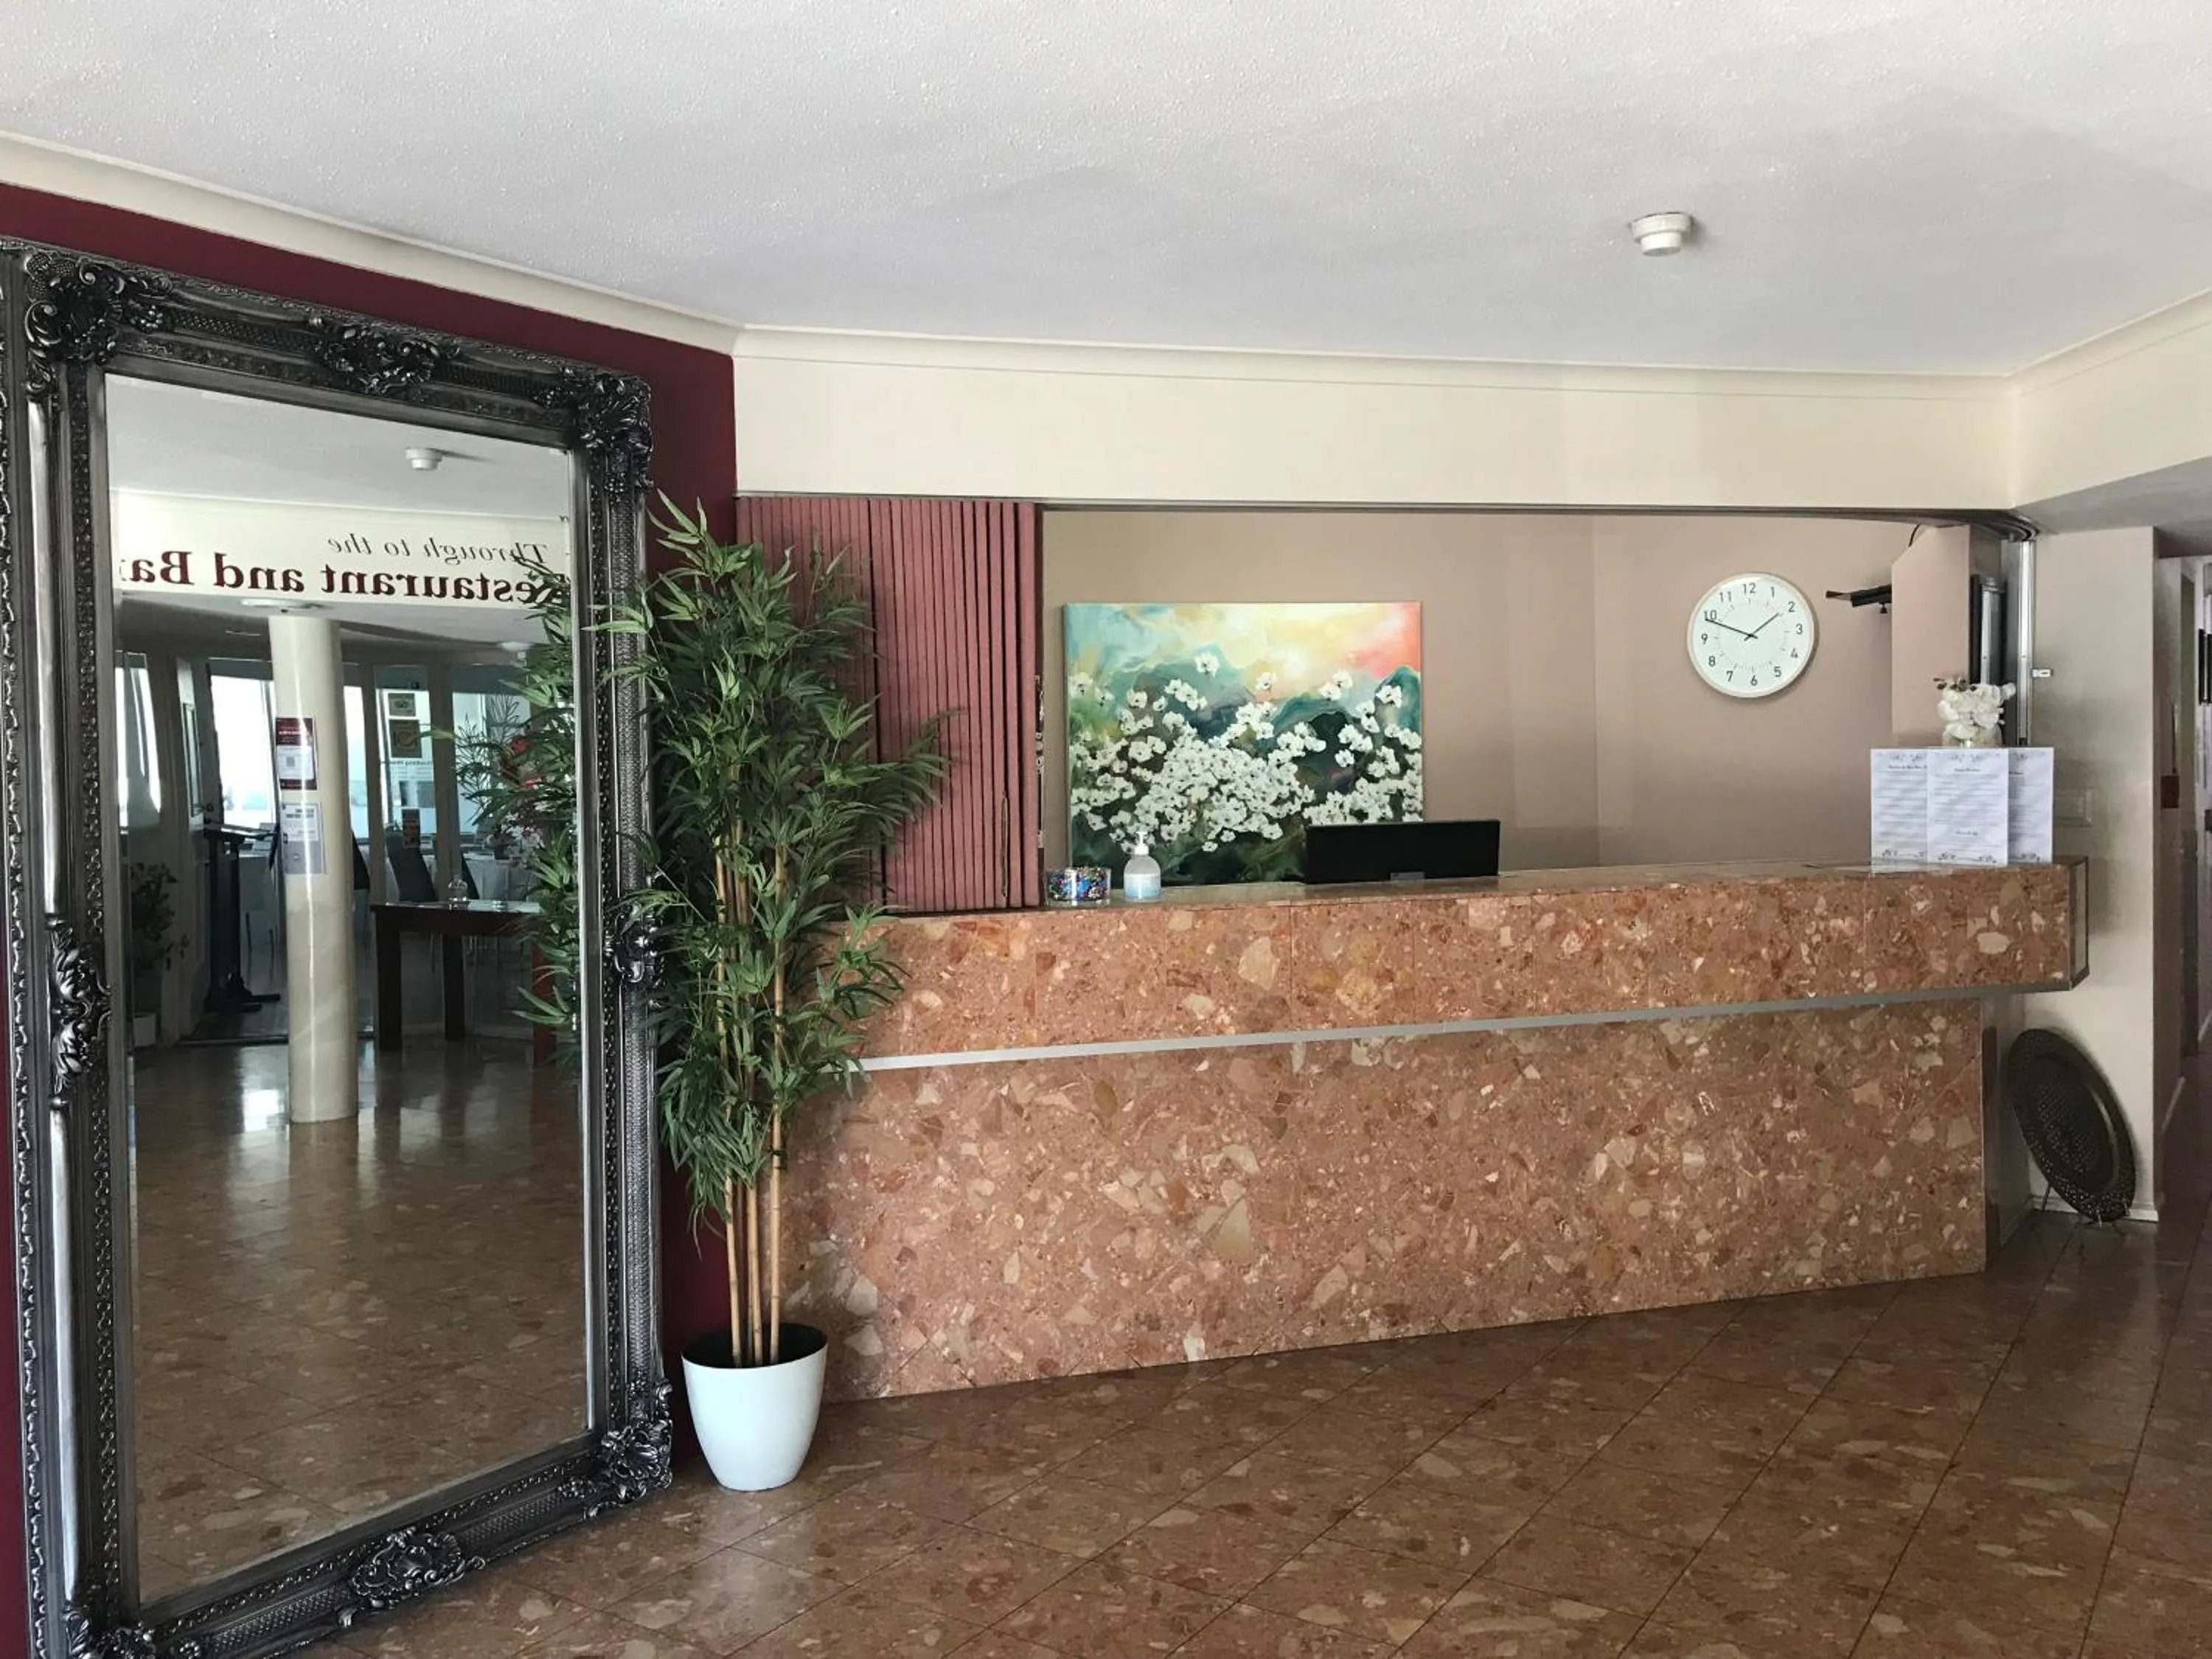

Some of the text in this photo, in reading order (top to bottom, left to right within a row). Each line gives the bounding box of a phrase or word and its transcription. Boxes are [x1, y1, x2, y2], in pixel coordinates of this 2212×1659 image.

[1742, 582, 1756, 594] 12
[1770, 586, 1775, 598] 1
[1719, 591, 1732, 602] 11
[1787, 601, 1795, 613] 2
[1703, 610, 1717, 621] 10
[1795, 623, 1804, 635] 3
[1700, 633, 1708, 644] 9
[1790, 647, 1798, 658] 4
[1708, 655, 1717, 667] 8
[1726, 670, 1733, 682] 7
[1774, 666, 1782, 678] 5
[1750, 675, 1758, 686] 6
